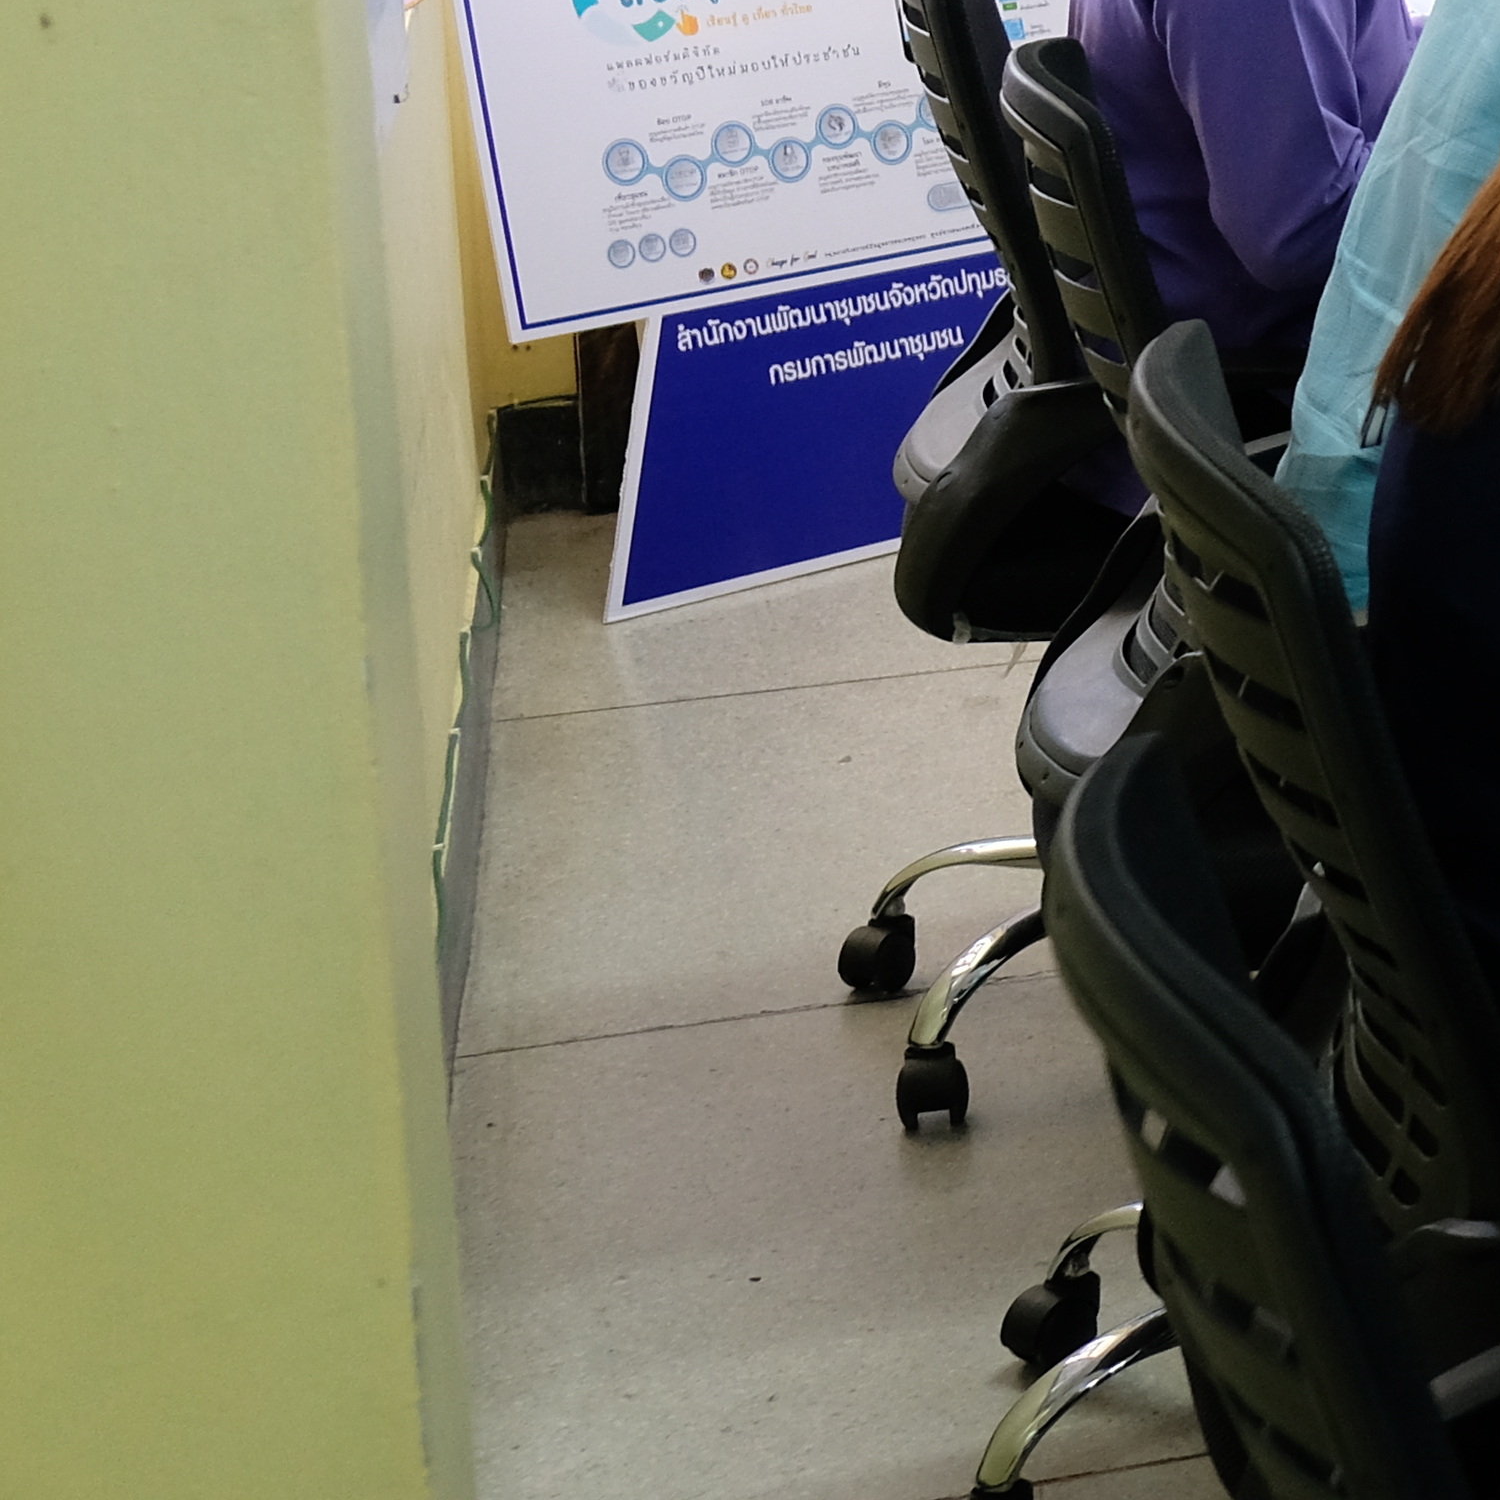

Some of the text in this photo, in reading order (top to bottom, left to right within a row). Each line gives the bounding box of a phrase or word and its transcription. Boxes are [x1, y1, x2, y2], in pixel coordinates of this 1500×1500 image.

[769, 325, 965, 386] กรมการพัฒนาชุมชน
